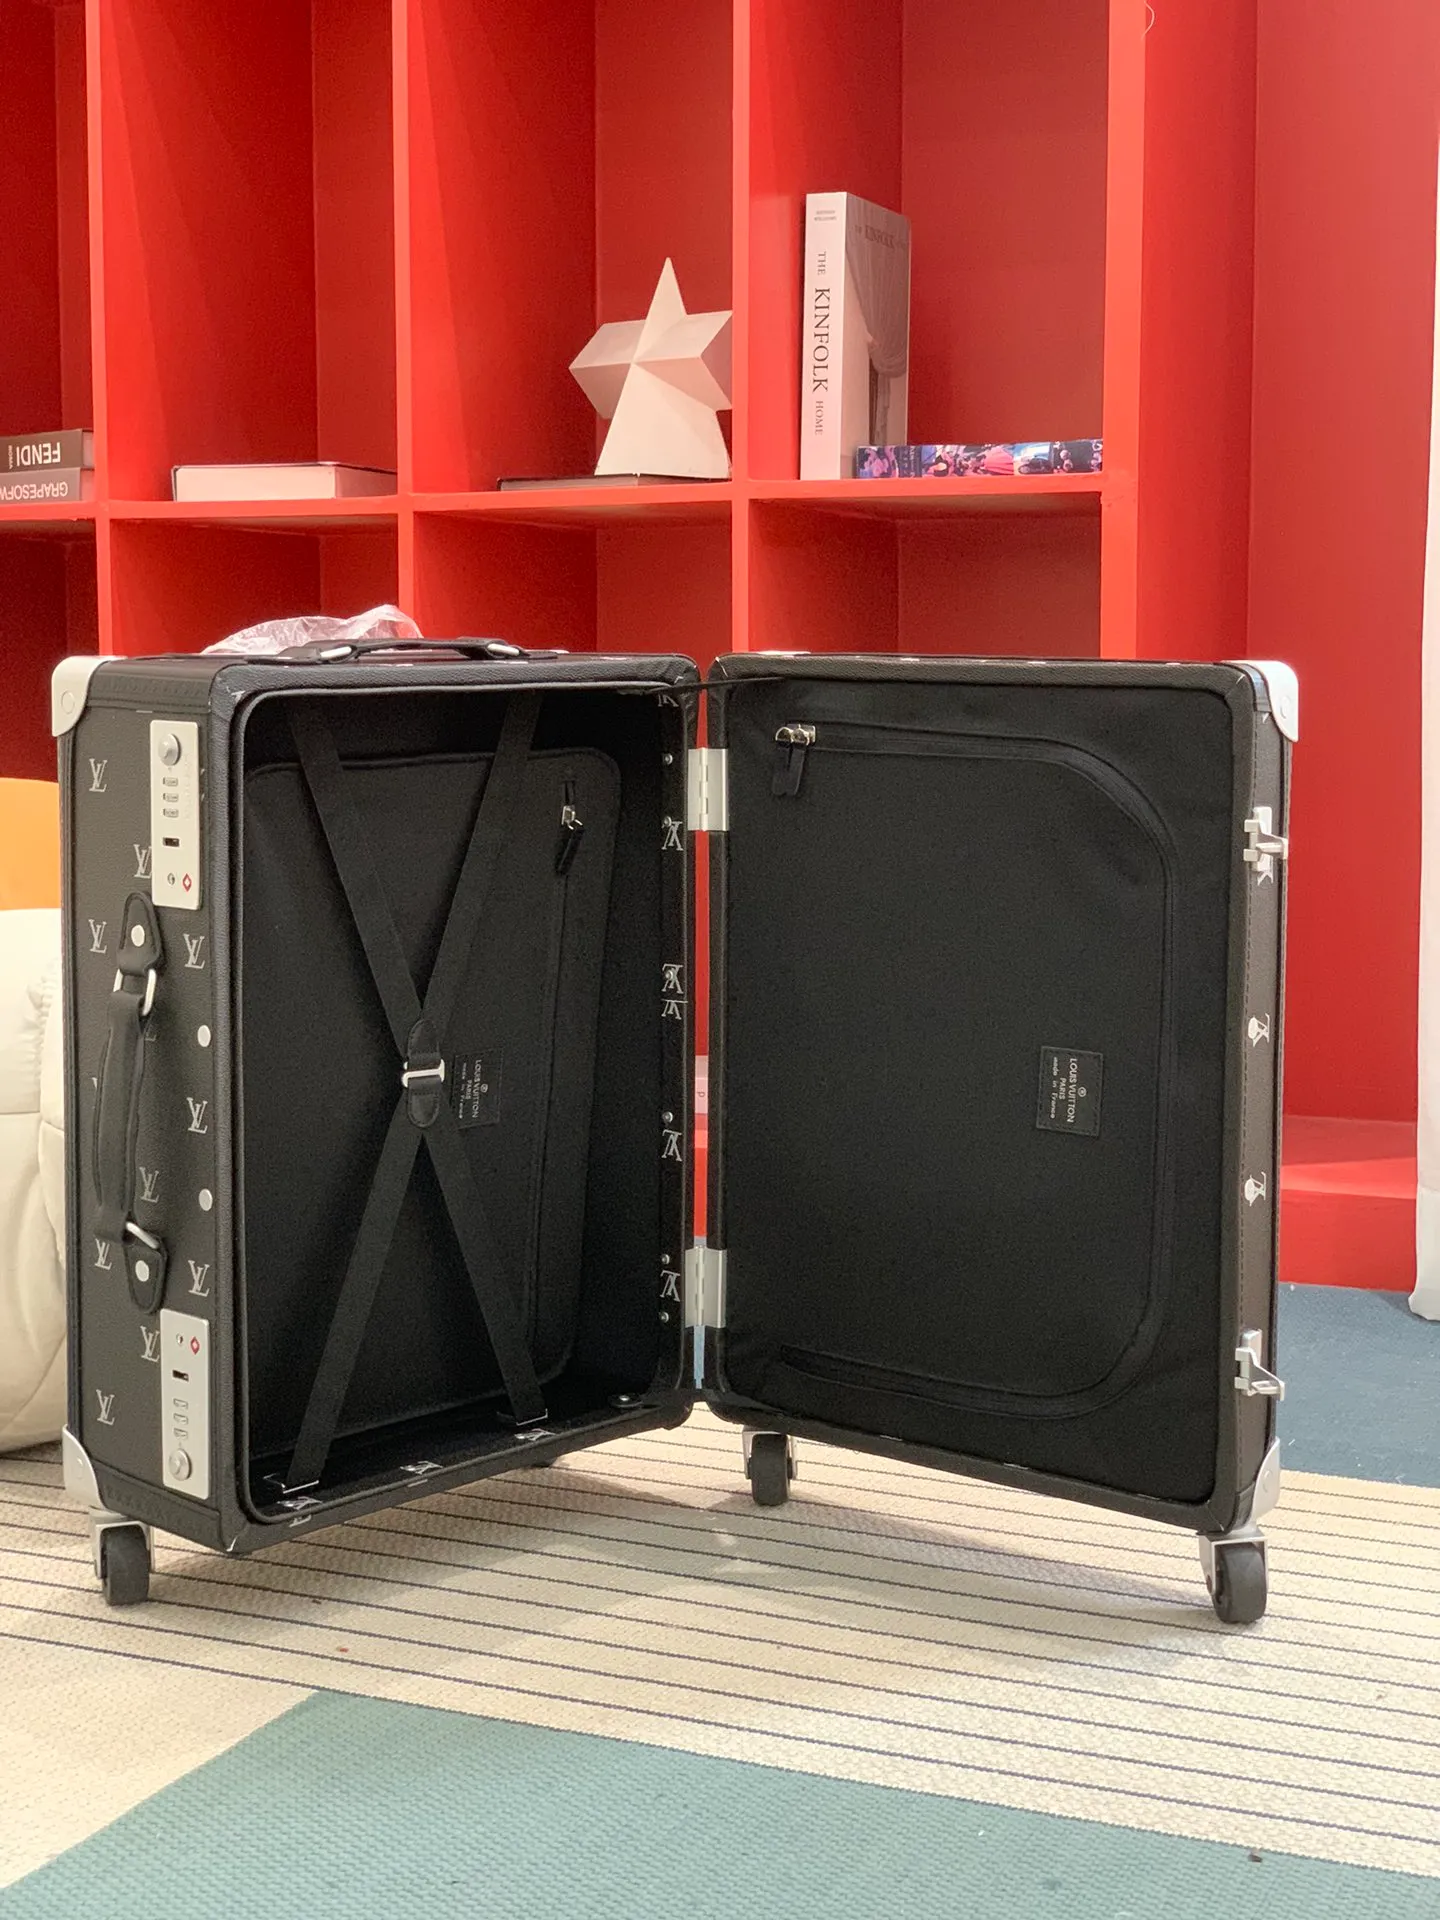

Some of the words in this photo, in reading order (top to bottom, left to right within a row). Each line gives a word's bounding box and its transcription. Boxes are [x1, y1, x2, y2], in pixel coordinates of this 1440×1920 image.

[817, 251, 827, 275] THE
[812, 288, 830, 392] KINFOLK
[815, 401, 824, 435] HOME
[16, 442, 61, 467] FENDI
[474, 1060, 482, 1082] LOUIS
[1069, 1058, 1078, 1083] LOUIS
[472, 1083, 480, 1118] VUITTON
[1050, 1093, 1058, 1118] France
[1067, 1084, 1076, 1122] VUITTON
